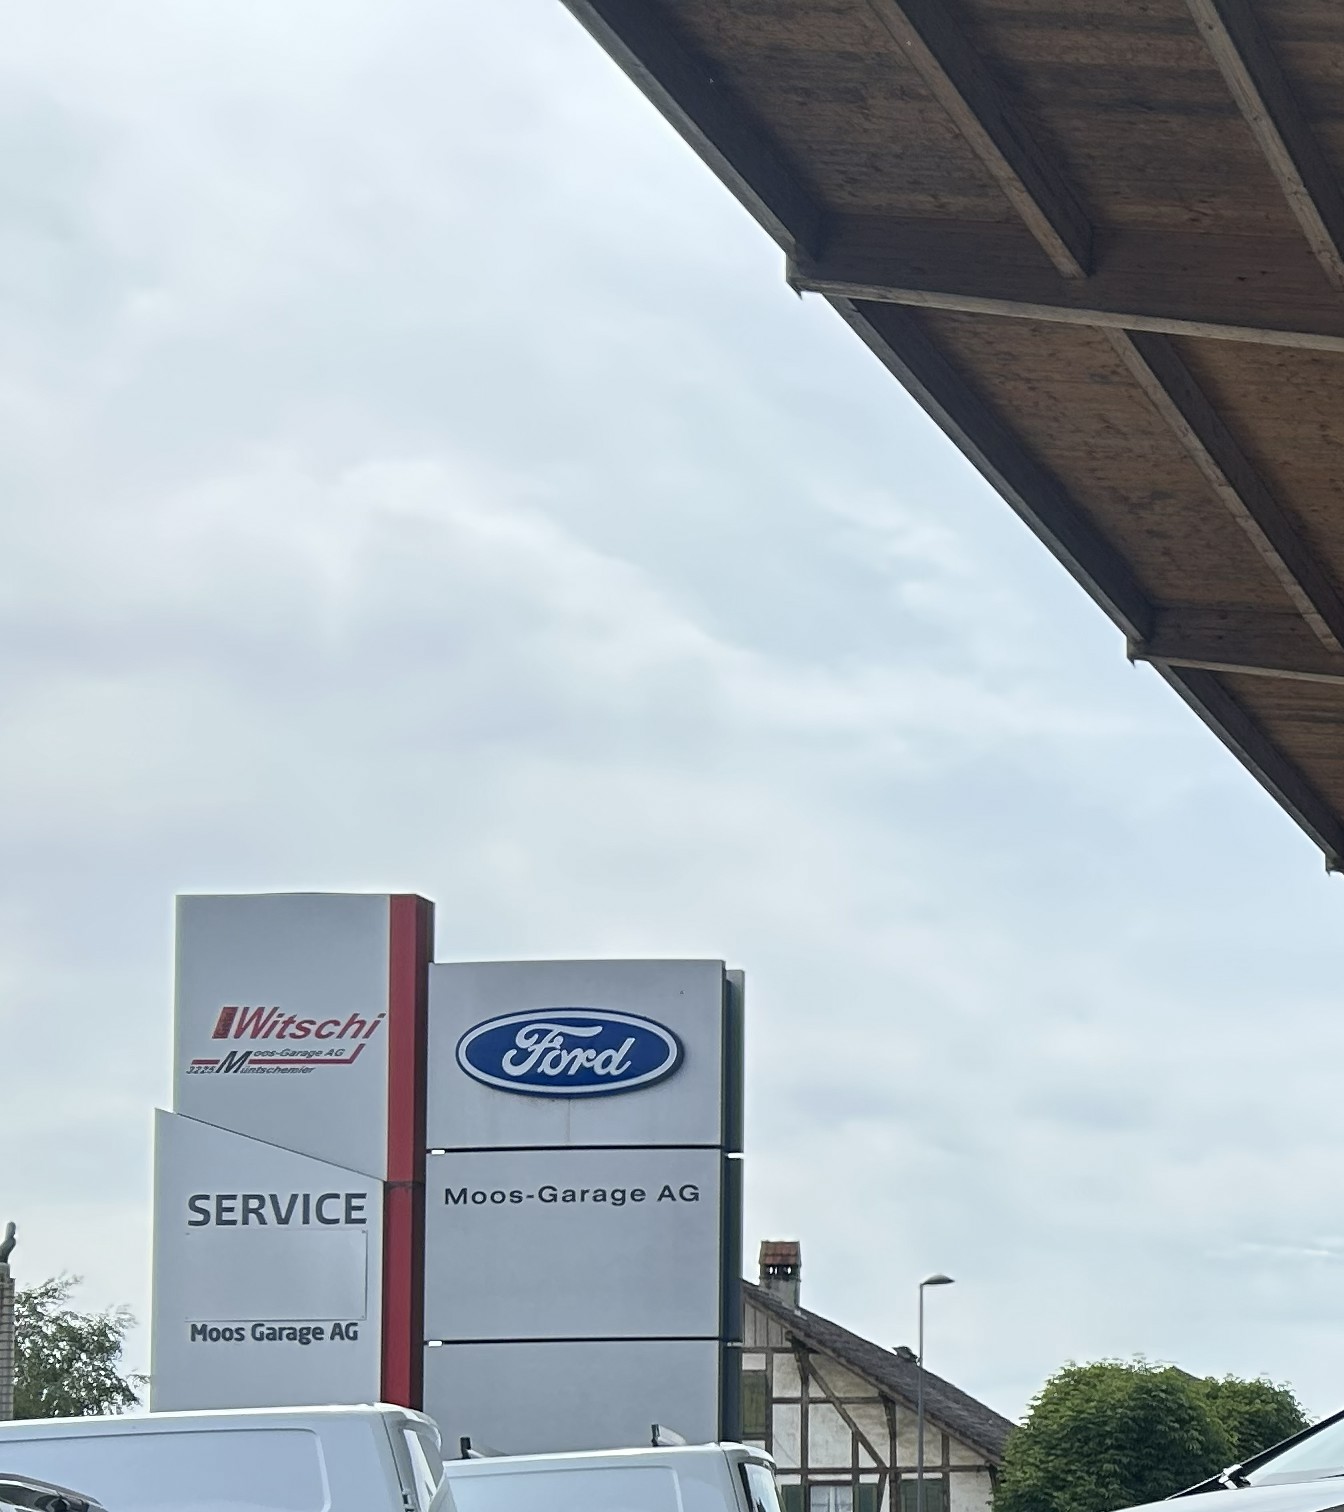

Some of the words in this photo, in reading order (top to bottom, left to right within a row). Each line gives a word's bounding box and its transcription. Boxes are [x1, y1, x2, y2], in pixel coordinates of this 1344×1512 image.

[233, 1006, 387, 1040] Witschi
[324, 1049, 345, 1057] AG
[502, 1023, 635, 1076] Ford
[187, 1192, 367, 1227] SERVICE
[444, 1185, 647, 1207] Moos-Garage
[656, 1184, 700, 1202] AG
[190, 1323, 245, 1342] Moos
[250, 1323, 325, 1345] Garage
[329, 1322, 358, 1341] AG
